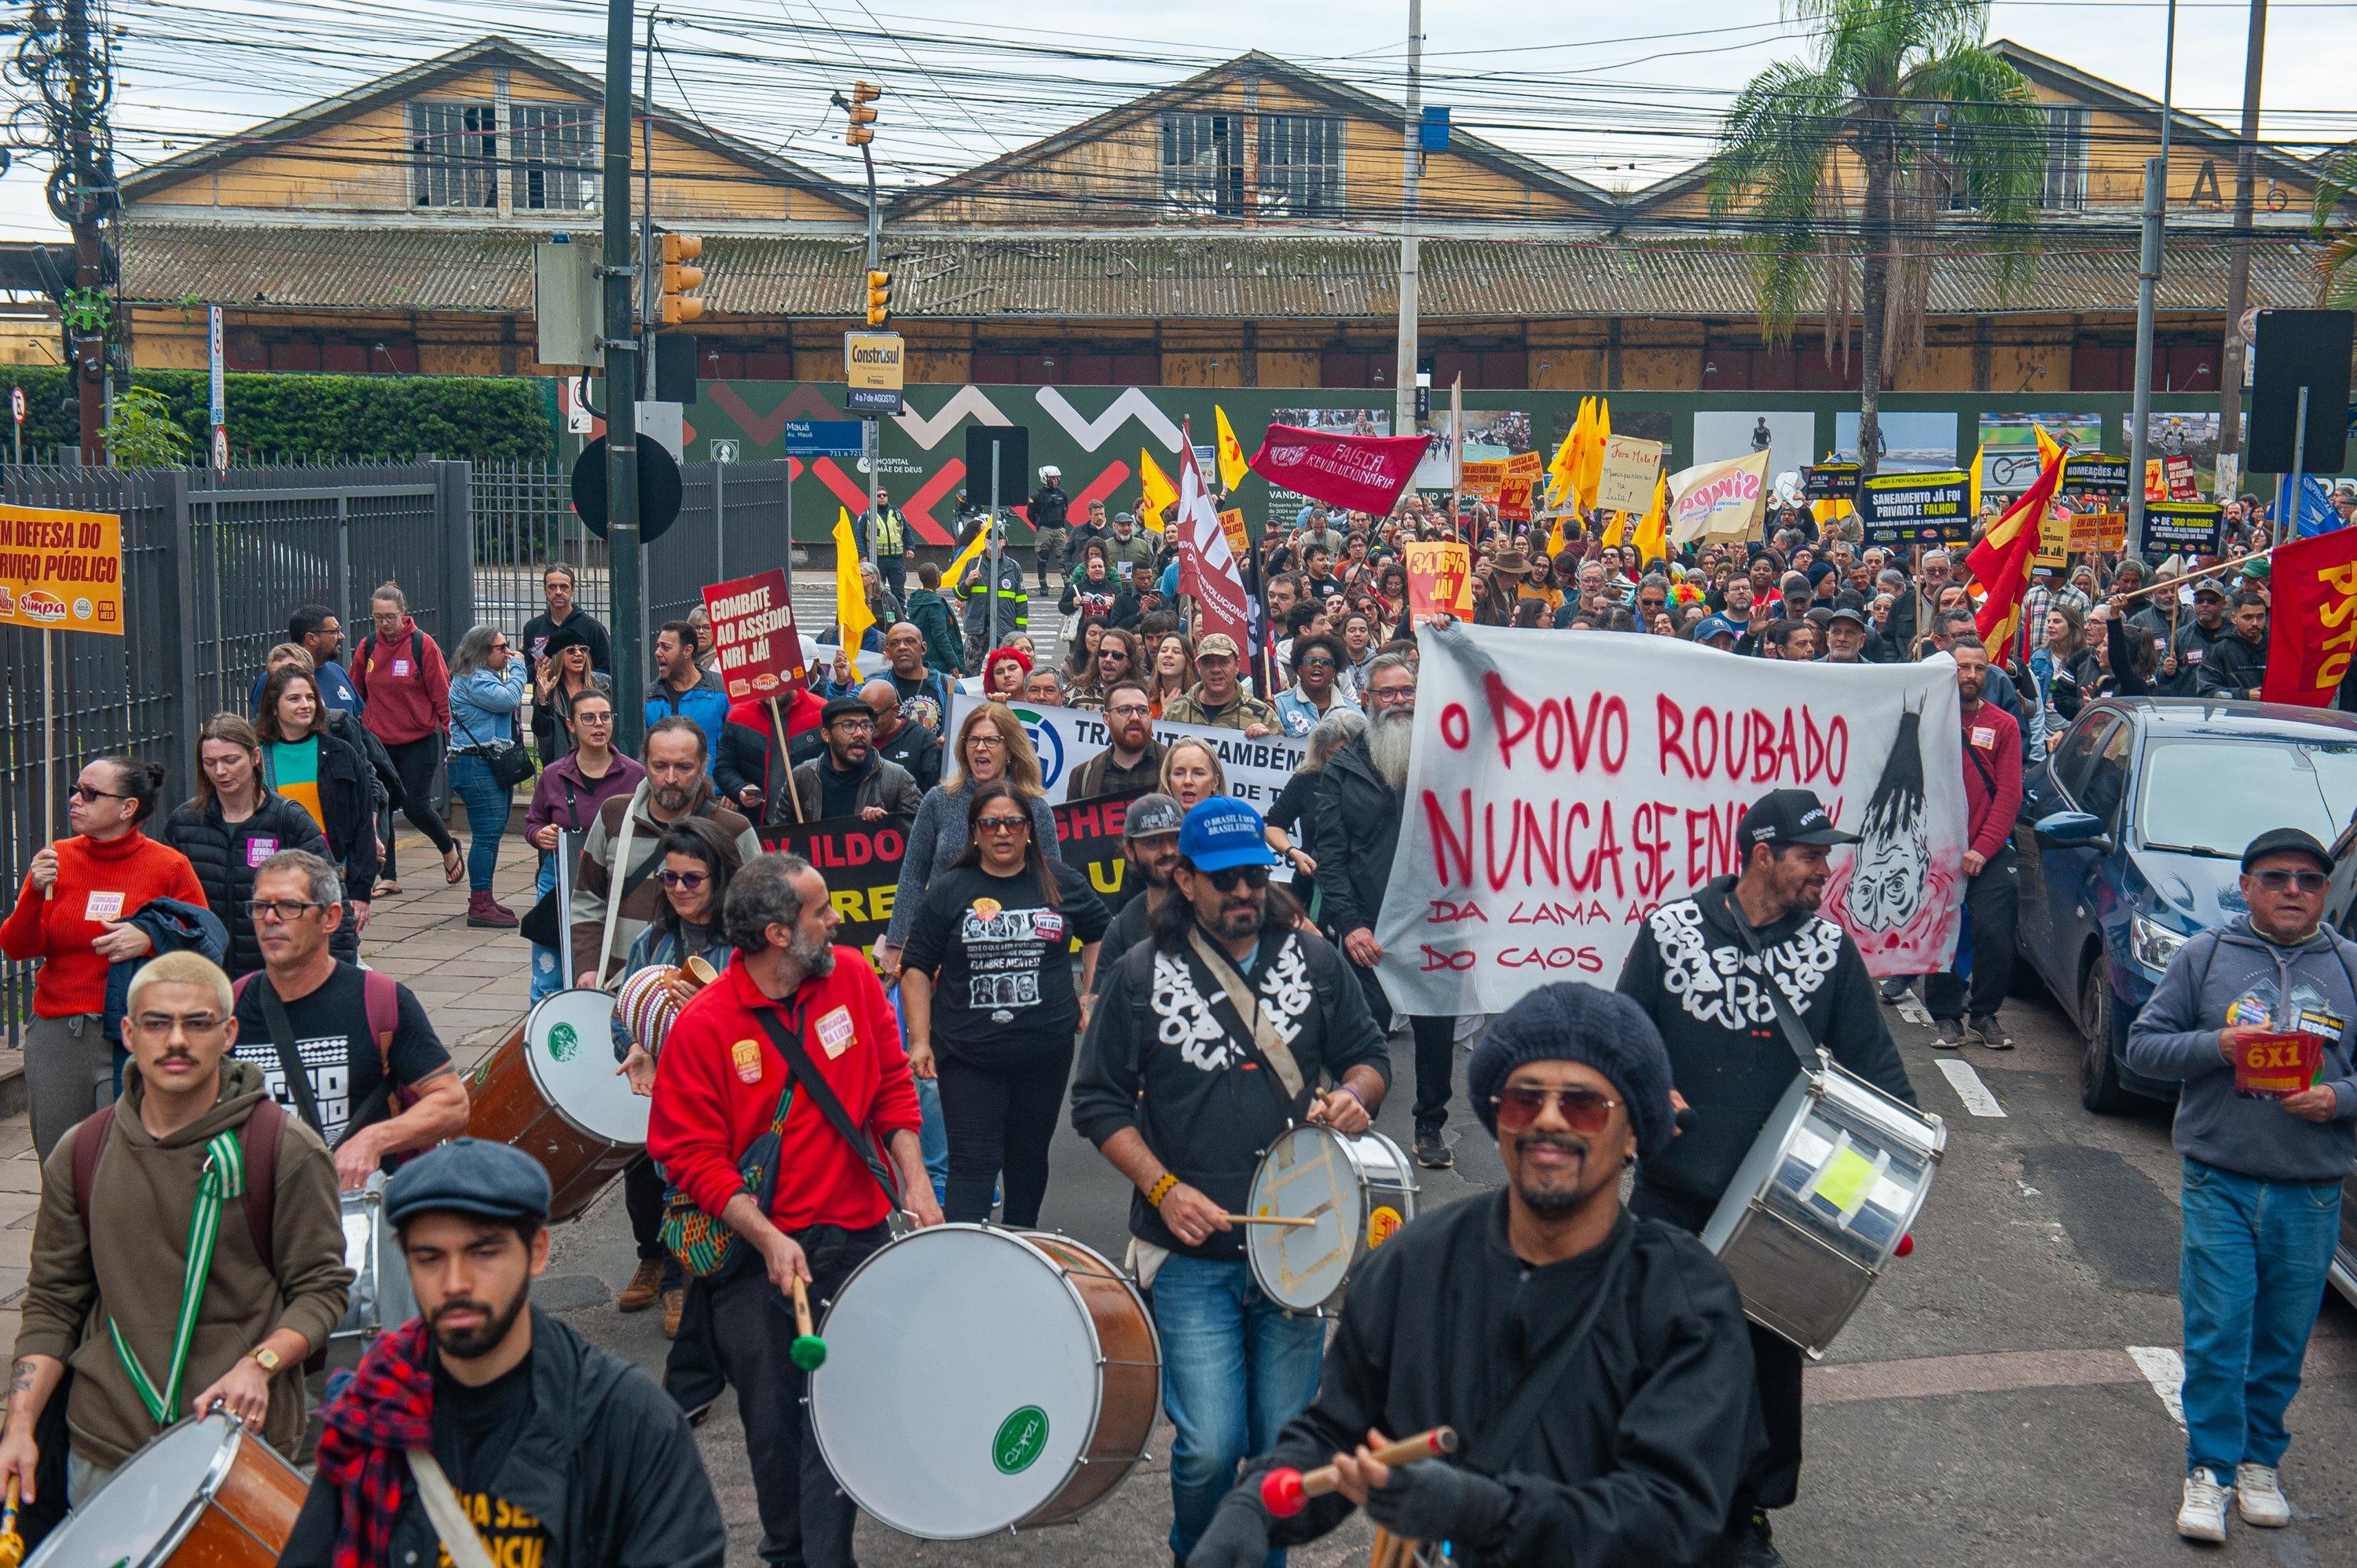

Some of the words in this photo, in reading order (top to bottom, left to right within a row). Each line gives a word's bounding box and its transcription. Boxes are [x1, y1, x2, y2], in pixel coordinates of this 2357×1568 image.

[855, 393, 859, 401] 4
[863, 393, 867, 402] 7
[867, 394, 874, 402] de
[874, 394, 896, 403] AGOSTO
[786, 423, 809, 431] Mauá
[1335, 444, 1384, 471] FAÍSCA
[1611, 441, 1629, 459] Fora
[1307, 454, 1395, 489] REVOLUCIONÁRIA
[2067, 465, 2112, 478] NOMEAÇÕES
[2113, 467, 2125, 478] JÁ!
[1269, 490, 1303, 500] VANDE
[1872, 492, 1930, 505] SANEAMENTO
[1933, 489, 1945, 503] JÁ
[1947, 490, 1961, 502] FOI
[1877, 504, 1914, 518] PRIVADO
[1916, 504, 1922, 515] E
[1924, 503, 1957, 515] FALHOU
[2070, 528, 2096, 539] SERVIÇO
[2099, 524, 2123, 536] PÚBLICO
[2077, 518, 2085, 527] EM
[2109, 516, 2117, 525] DO
[2161, 517, 2170, 526] DE
[2187, 518, 2214, 528] CIDADES
[16, 521, 74, 548] DEFESA
[79, 522, 101, 549] DO
[2051, 545, 2064, 557] JÁ!
[43, 551, 117, 584] PÚBLICO
[1412, 551, 1467, 577] 34,16%
[1429, 574, 1453, 601] JÁ!
[20, 595, 65, 616] Simpa
[710, 586, 771, 623] COMBATE
[1198, 580, 1235, 625] ALHADORES
[717, 622, 735, 647] AO
[738, 605, 791, 641] ASSÉDIO
[2315, 559, 2357, 689] PSTU
[721, 645, 746, 670] NR1
[749, 634, 770, 664] JÁ!
[1440, 702, 1470, 751] O
[1483, 670, 1629, 775] POVO
[1656, 692, 1849, 788] ROUBADO
[1233, 782, 1261, 801] DE
[1208, 824, 1256, 836] BRASILEIROS
[1211, 814, 1237, 826] BRASIL
[810, 830, 904, 868] ILDO
[1422, 787, 1623, 898] NUNCA
[1633, 801, 1677, 899] SE
[1426, 899, 1488, 925] DA
[1508, 899, 1611, 928] LAMA
[1048, 921, 1061, 930] LUTA
[970, 961, 983, 970] ELA
[984, 958, 1004, 969] ABRE
[1006, 957, 1040, 969] MENTES!
[1420, 943, 1476, 972] DO
[1497, 947, 1604, 973] CAOS
[823, 1033, 835, 1046] NA
[2247, 1042, 2302, 1068] 6X1
